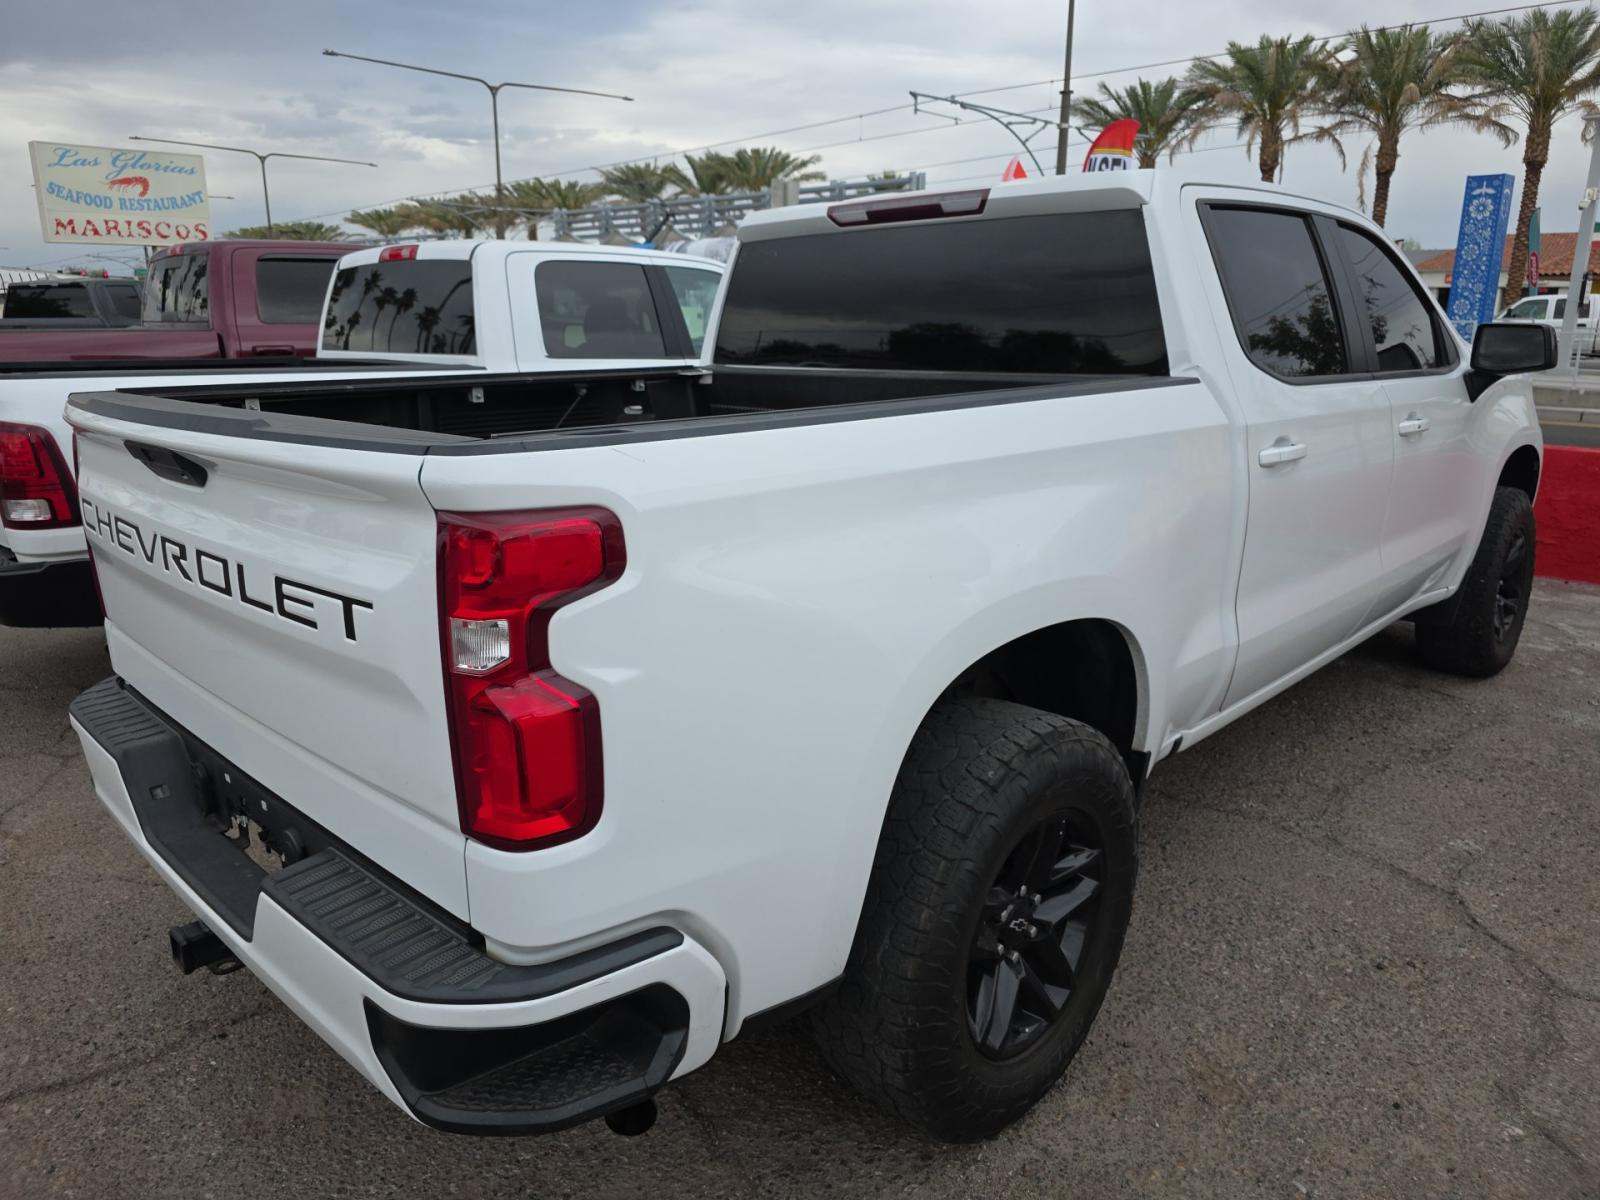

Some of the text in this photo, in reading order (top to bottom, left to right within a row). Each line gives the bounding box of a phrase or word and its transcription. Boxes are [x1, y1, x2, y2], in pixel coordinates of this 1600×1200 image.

[48, 147, 197, 180] Las Glorias
[46, 181, 204, 212] SEAFOOD RESTAURANT
[54, 217, 209, 241] MARISCOS
[82, 498, 374, 641] CHEVROLET
